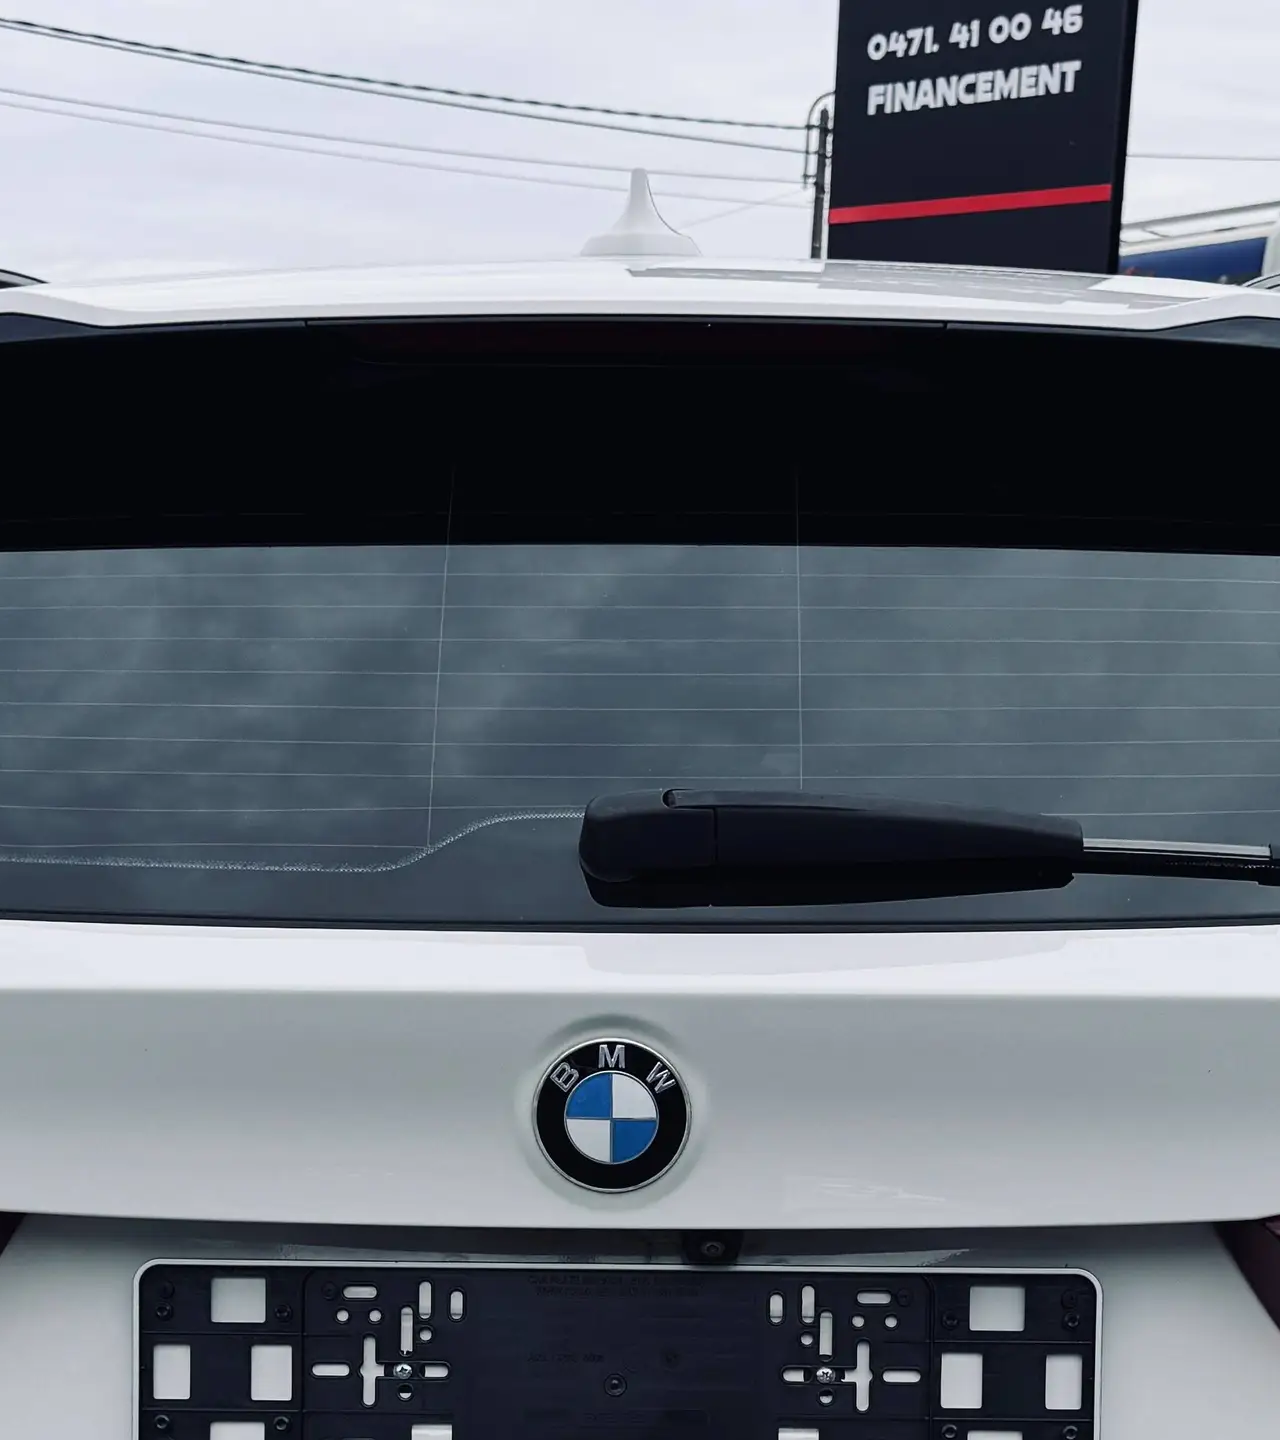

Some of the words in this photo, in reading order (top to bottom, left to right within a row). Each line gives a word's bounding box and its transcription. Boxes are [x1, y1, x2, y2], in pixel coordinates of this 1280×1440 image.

[867, 25, 940, 61] 0471.
[948, 19, 981, 49] 41
[988, 12, 1032, 44] 00
[1041, 4, 1083, 36] 46
[867, 60, 1082, 116] FINANCEMENT
[549, 1043, 677, 1095] BMW
